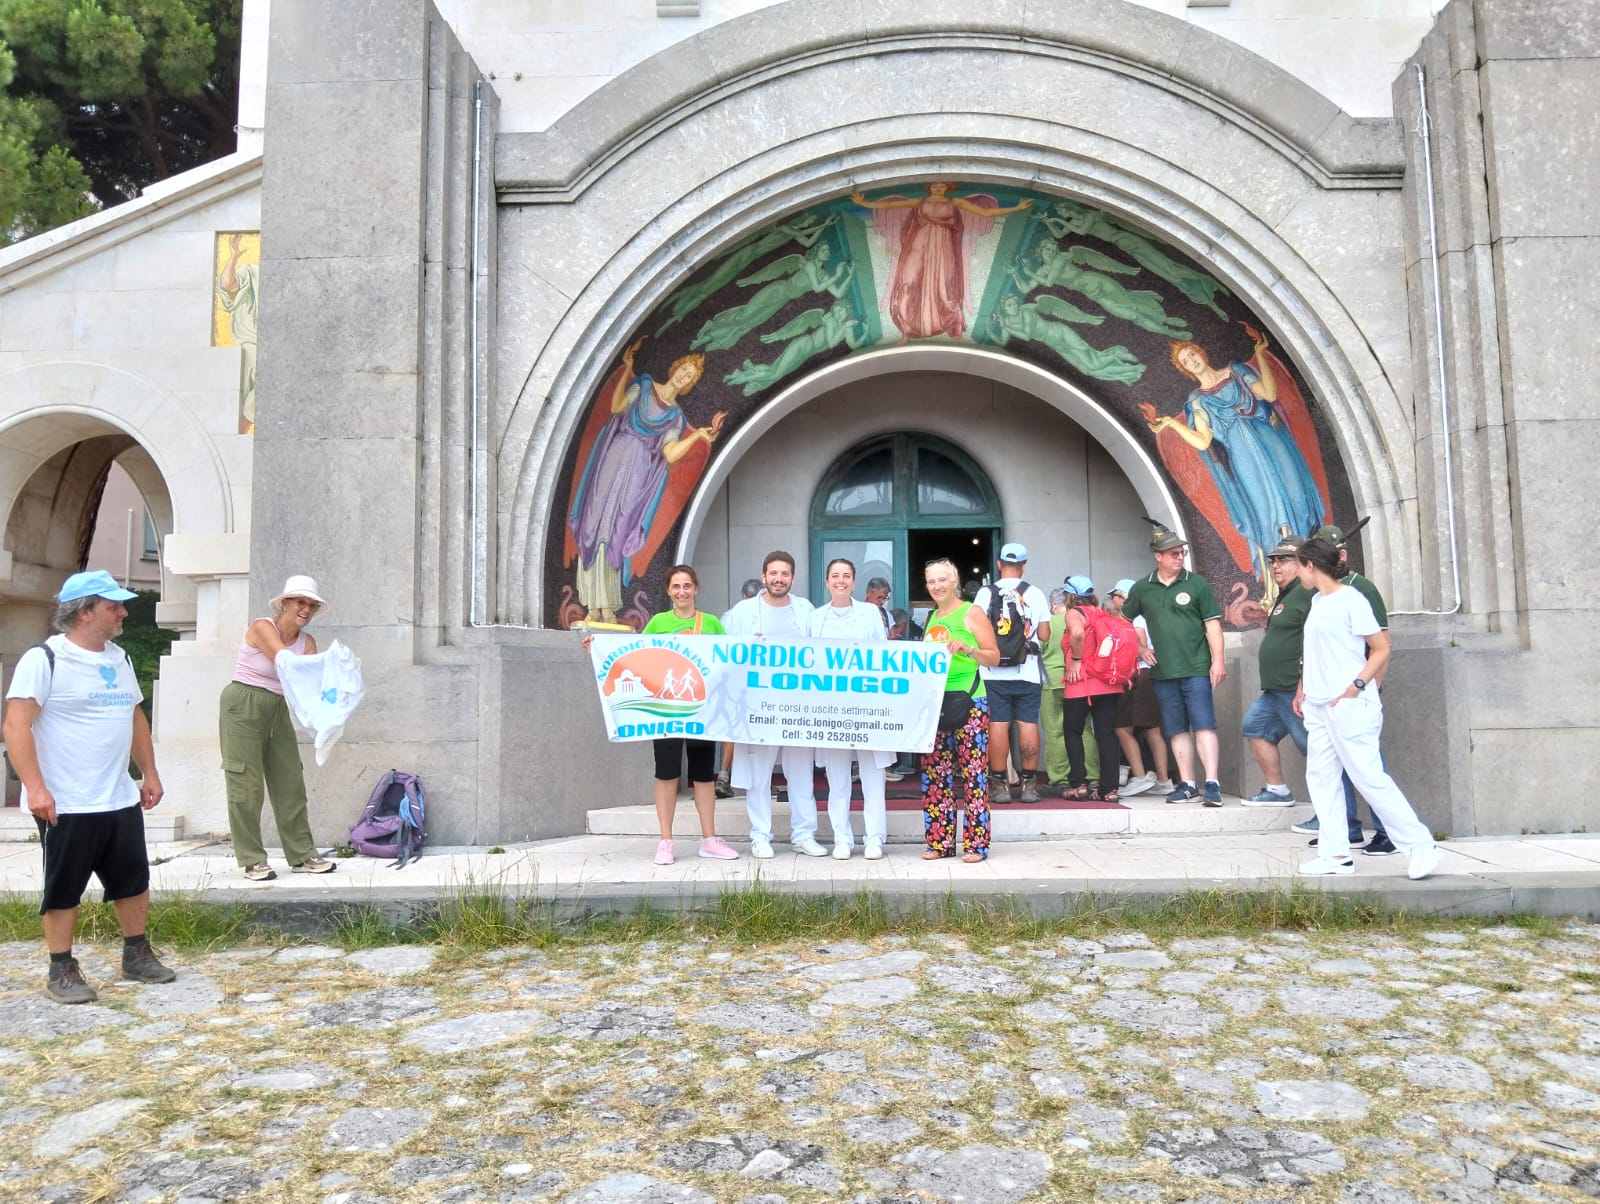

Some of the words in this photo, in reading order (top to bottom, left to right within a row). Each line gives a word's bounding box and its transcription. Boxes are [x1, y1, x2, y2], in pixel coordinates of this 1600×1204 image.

[597, 639, 646, 681] NORDIC
[651, 638, 711, 677] WALKING
[712, 642, 815, 669] NORDIC
[824, 647, 947, 675] WALKING
[746, 671, 910, 695] LONIGO
[761, 701, 776, 711] Per
[778, 703, 801, 713] corsi
[803, 705, 809, 713] e
[811, 704, 839, 714] uscite
[841, 705, 893, 717] settimanali:
[616, 720, 705, 738] ONIGO
[749, 714, 779, 725] Email:
[781, 717, 904, 731] nordic.lonigo@gmail.com
[782, 729, 803, 740] Cell:
[806, 730, 824, 741] 349
[826, 732, 869, 743] 2528055
